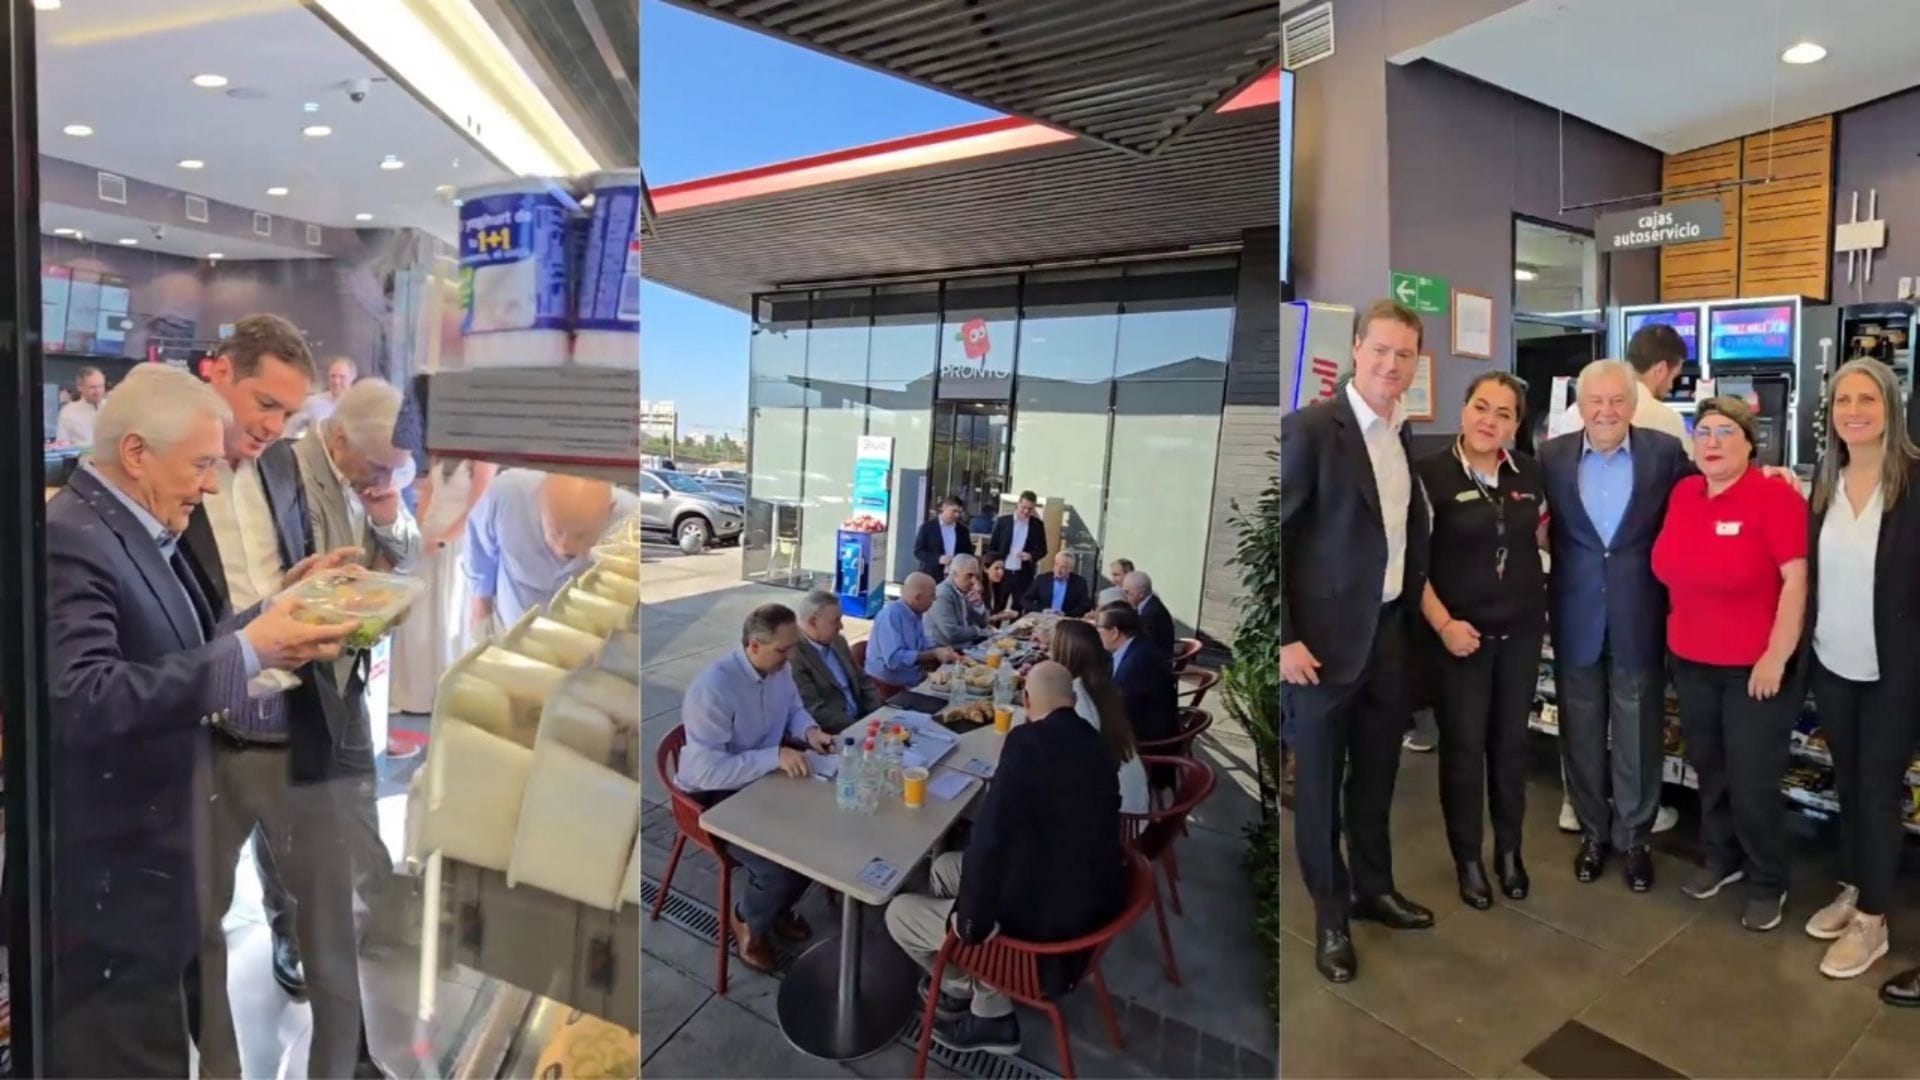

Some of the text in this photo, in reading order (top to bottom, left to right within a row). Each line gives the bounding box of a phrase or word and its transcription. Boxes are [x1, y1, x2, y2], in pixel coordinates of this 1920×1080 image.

[1638, 211, 1674, 230] cajas
[478, 227, 511, 252] 1+1
[1613, 221, 1701, 247] autoservicio
[941, 365, 1009, 379] PRONTO
[1308, 356, 1338, 406] ull
